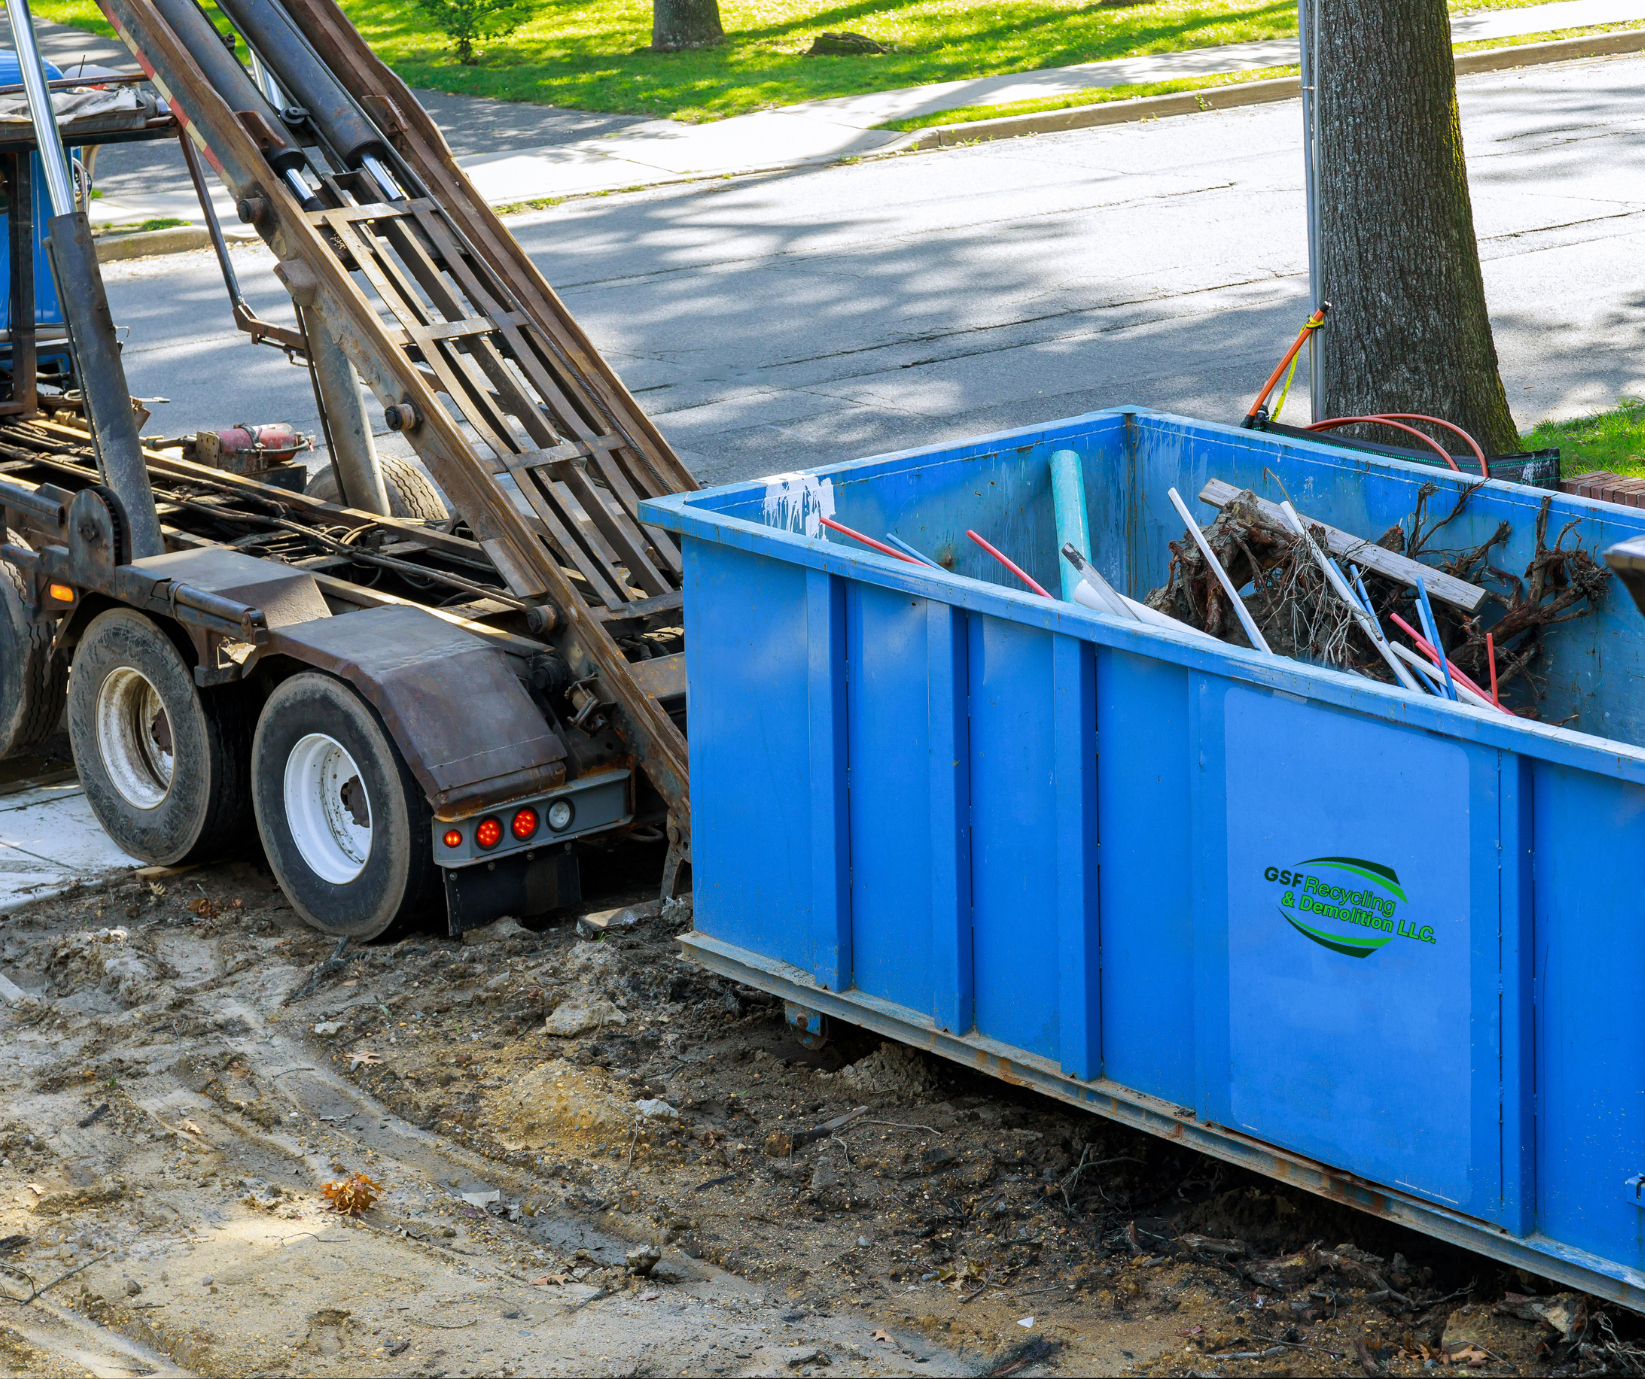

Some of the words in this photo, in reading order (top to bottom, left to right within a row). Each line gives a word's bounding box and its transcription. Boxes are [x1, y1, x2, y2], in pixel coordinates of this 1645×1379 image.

[1264, 866, 1304, 887] GSF
[1303, 876, 1396, 917] Recycling
[1281, 891, 1295, 908] &
[1299, 895, 1394, 933] Demolition
[1397, 919, 1436, 944] LLC.
